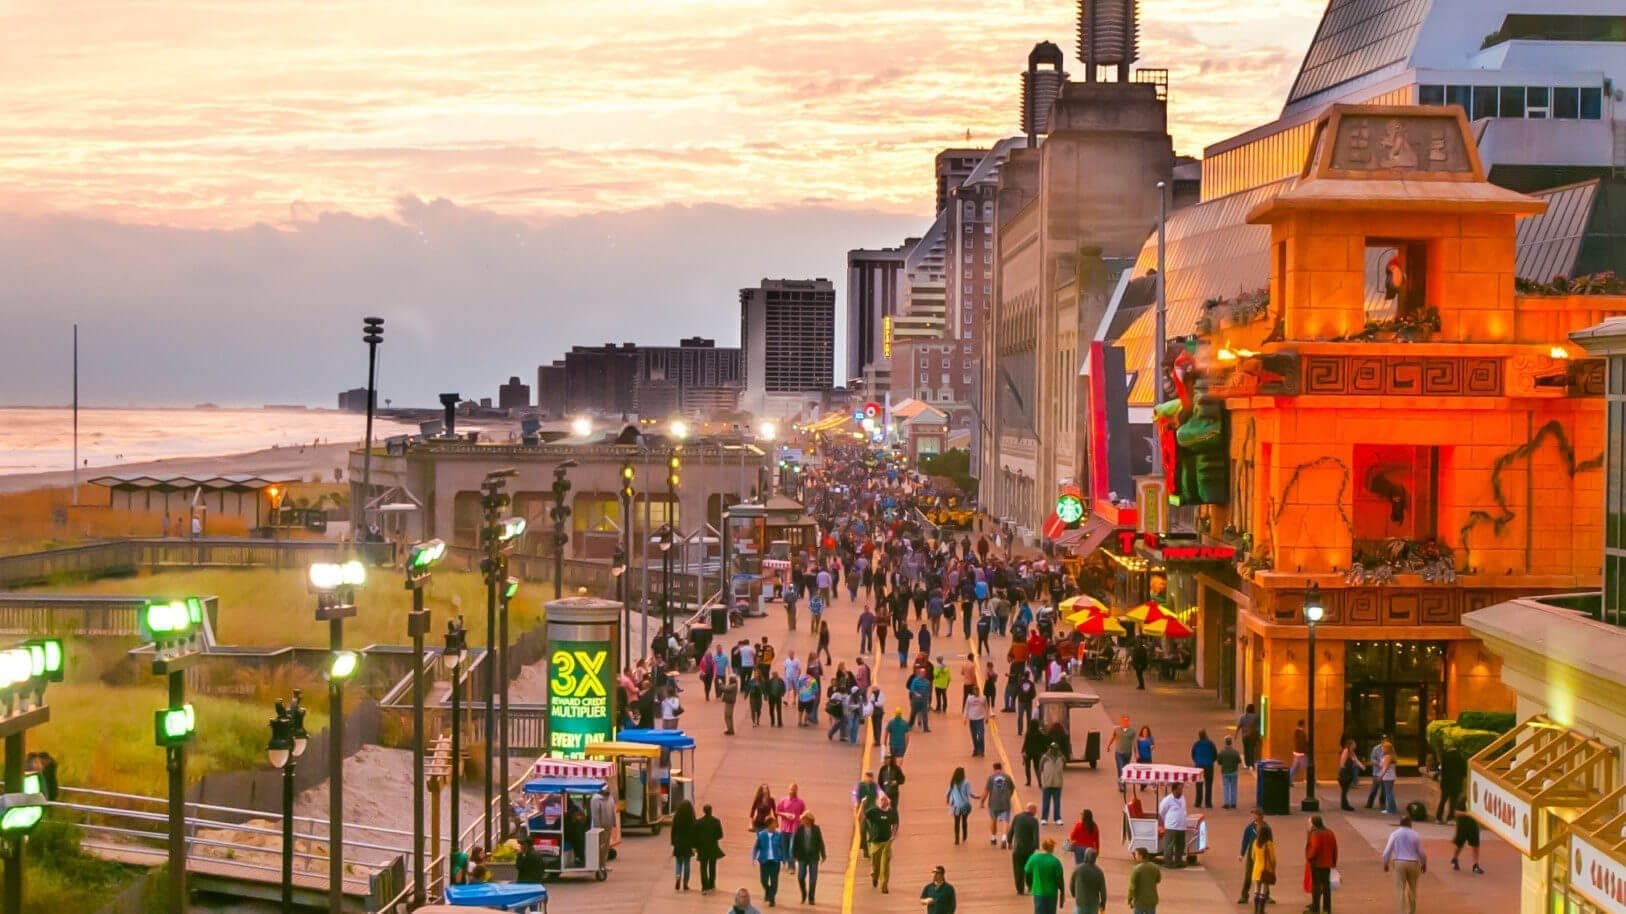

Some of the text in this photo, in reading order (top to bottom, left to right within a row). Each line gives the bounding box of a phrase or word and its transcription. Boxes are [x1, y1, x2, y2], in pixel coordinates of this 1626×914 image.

[551, 651, 607, 697] 3X
[581, 697, 606, 706] CREDIT
[551, 706, 606, 717] MULTIPLIER
[551, 732, 582, 748] EVERY
[584, 733, 605, 745] DAY
[1484, 789, 1516, 829] CAESARS
